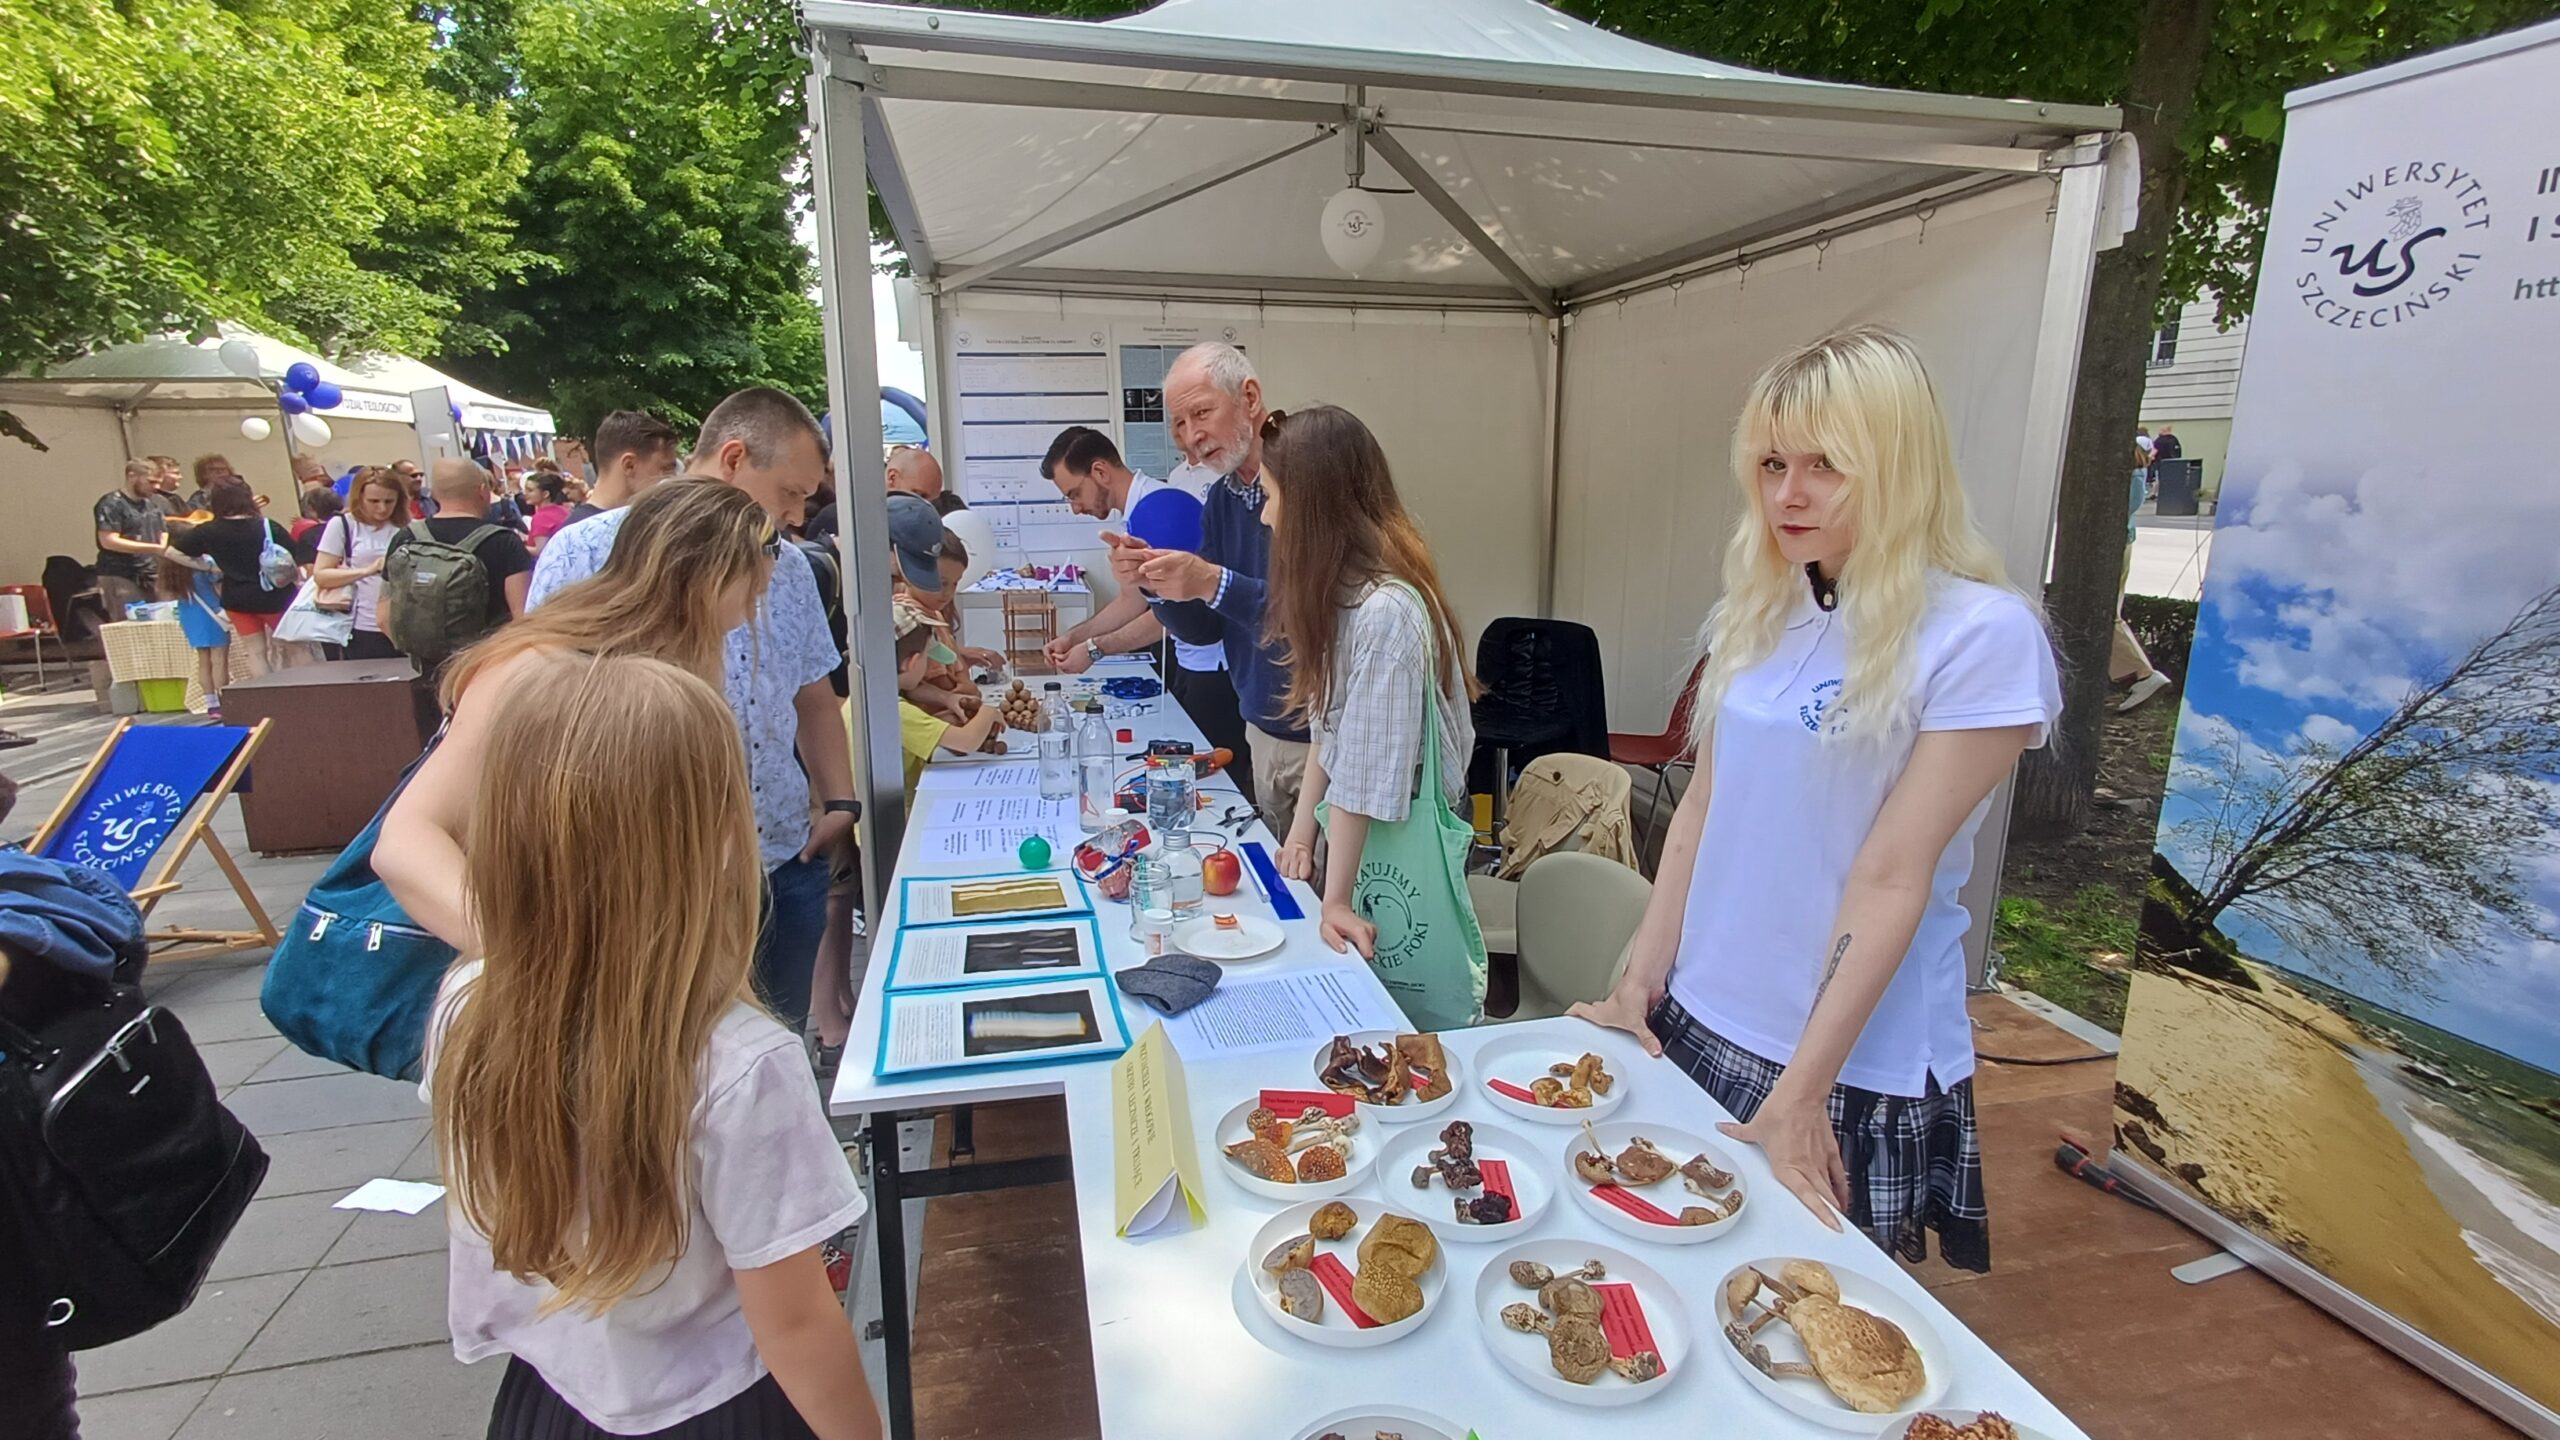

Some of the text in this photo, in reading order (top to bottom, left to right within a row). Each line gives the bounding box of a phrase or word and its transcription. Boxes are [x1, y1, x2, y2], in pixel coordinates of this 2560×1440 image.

[2301, 162, 2490, 253] UNIWERSYTET
[2296, 252, 2482, 330] SZCZECIŃSKI
[1404, 922, 1429, 959] FOKI
